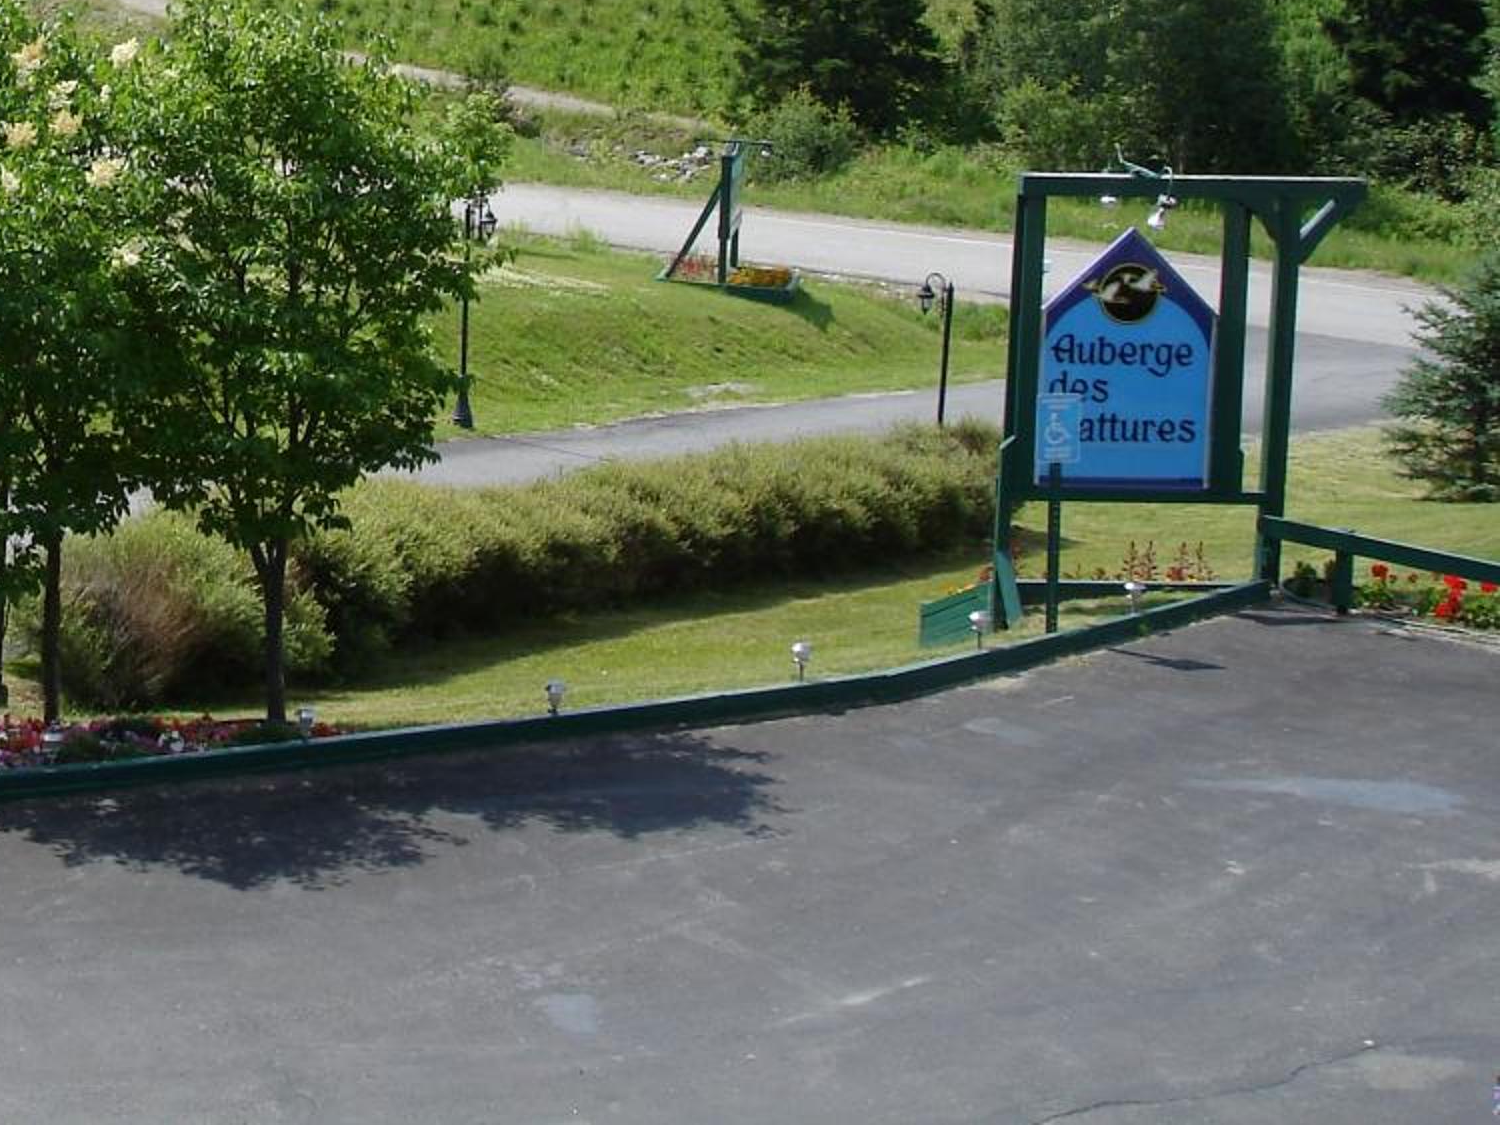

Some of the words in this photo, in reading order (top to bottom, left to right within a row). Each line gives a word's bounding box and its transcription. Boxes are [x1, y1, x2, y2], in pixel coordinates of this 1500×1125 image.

[1051, 333, 1194, 378] Auberge
[1049, 369, 1110, 404] des
[1078, 412, 1197, 443] attures
